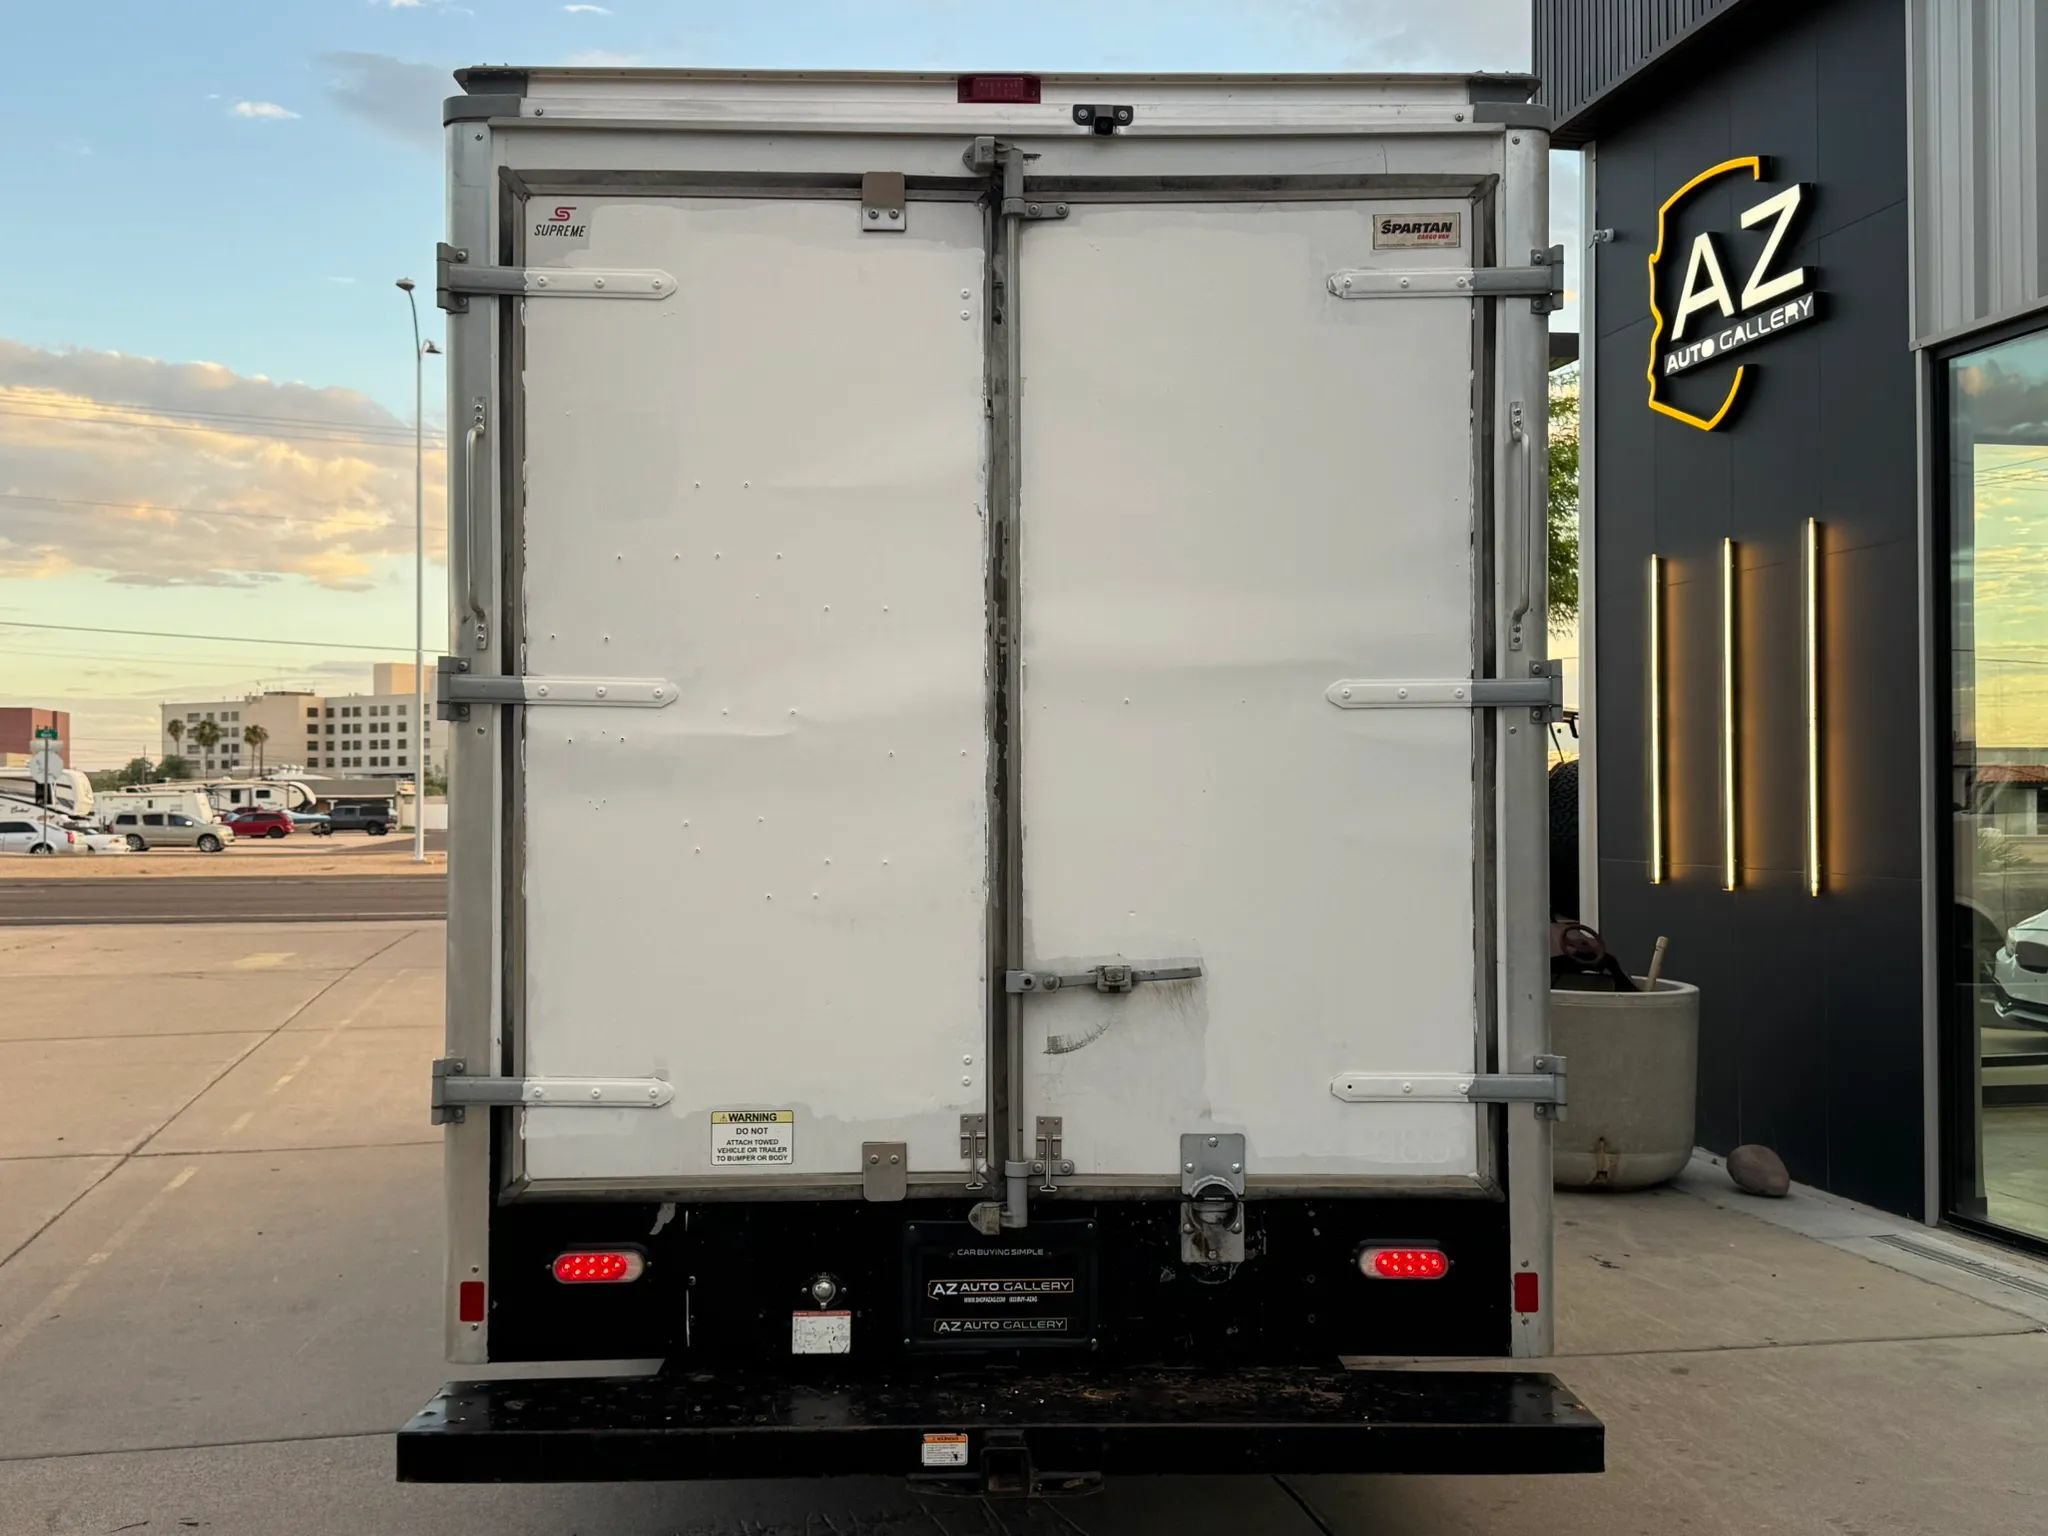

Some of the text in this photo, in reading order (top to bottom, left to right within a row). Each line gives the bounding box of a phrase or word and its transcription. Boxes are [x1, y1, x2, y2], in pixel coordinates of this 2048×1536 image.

[534, 224, 586, 237] SUPREME
[1381, 219, 1453, 234] SPARTAN
[1670, 183, 1805, 342] AZ
[1666, 295, 1813, 374] AUTO GALLERY
[728, 1113, 777, 1121] WARNING
[736, 1127, 768, 1135] DO NOT
[957, 1248, 1044, 1256] CAR BUYING SIMPLE
[933, 1281, 1070, 1295] AZ AUTO GALLERY
[938, 1320, 1064, 1332] AZ AUTO GALLERY
